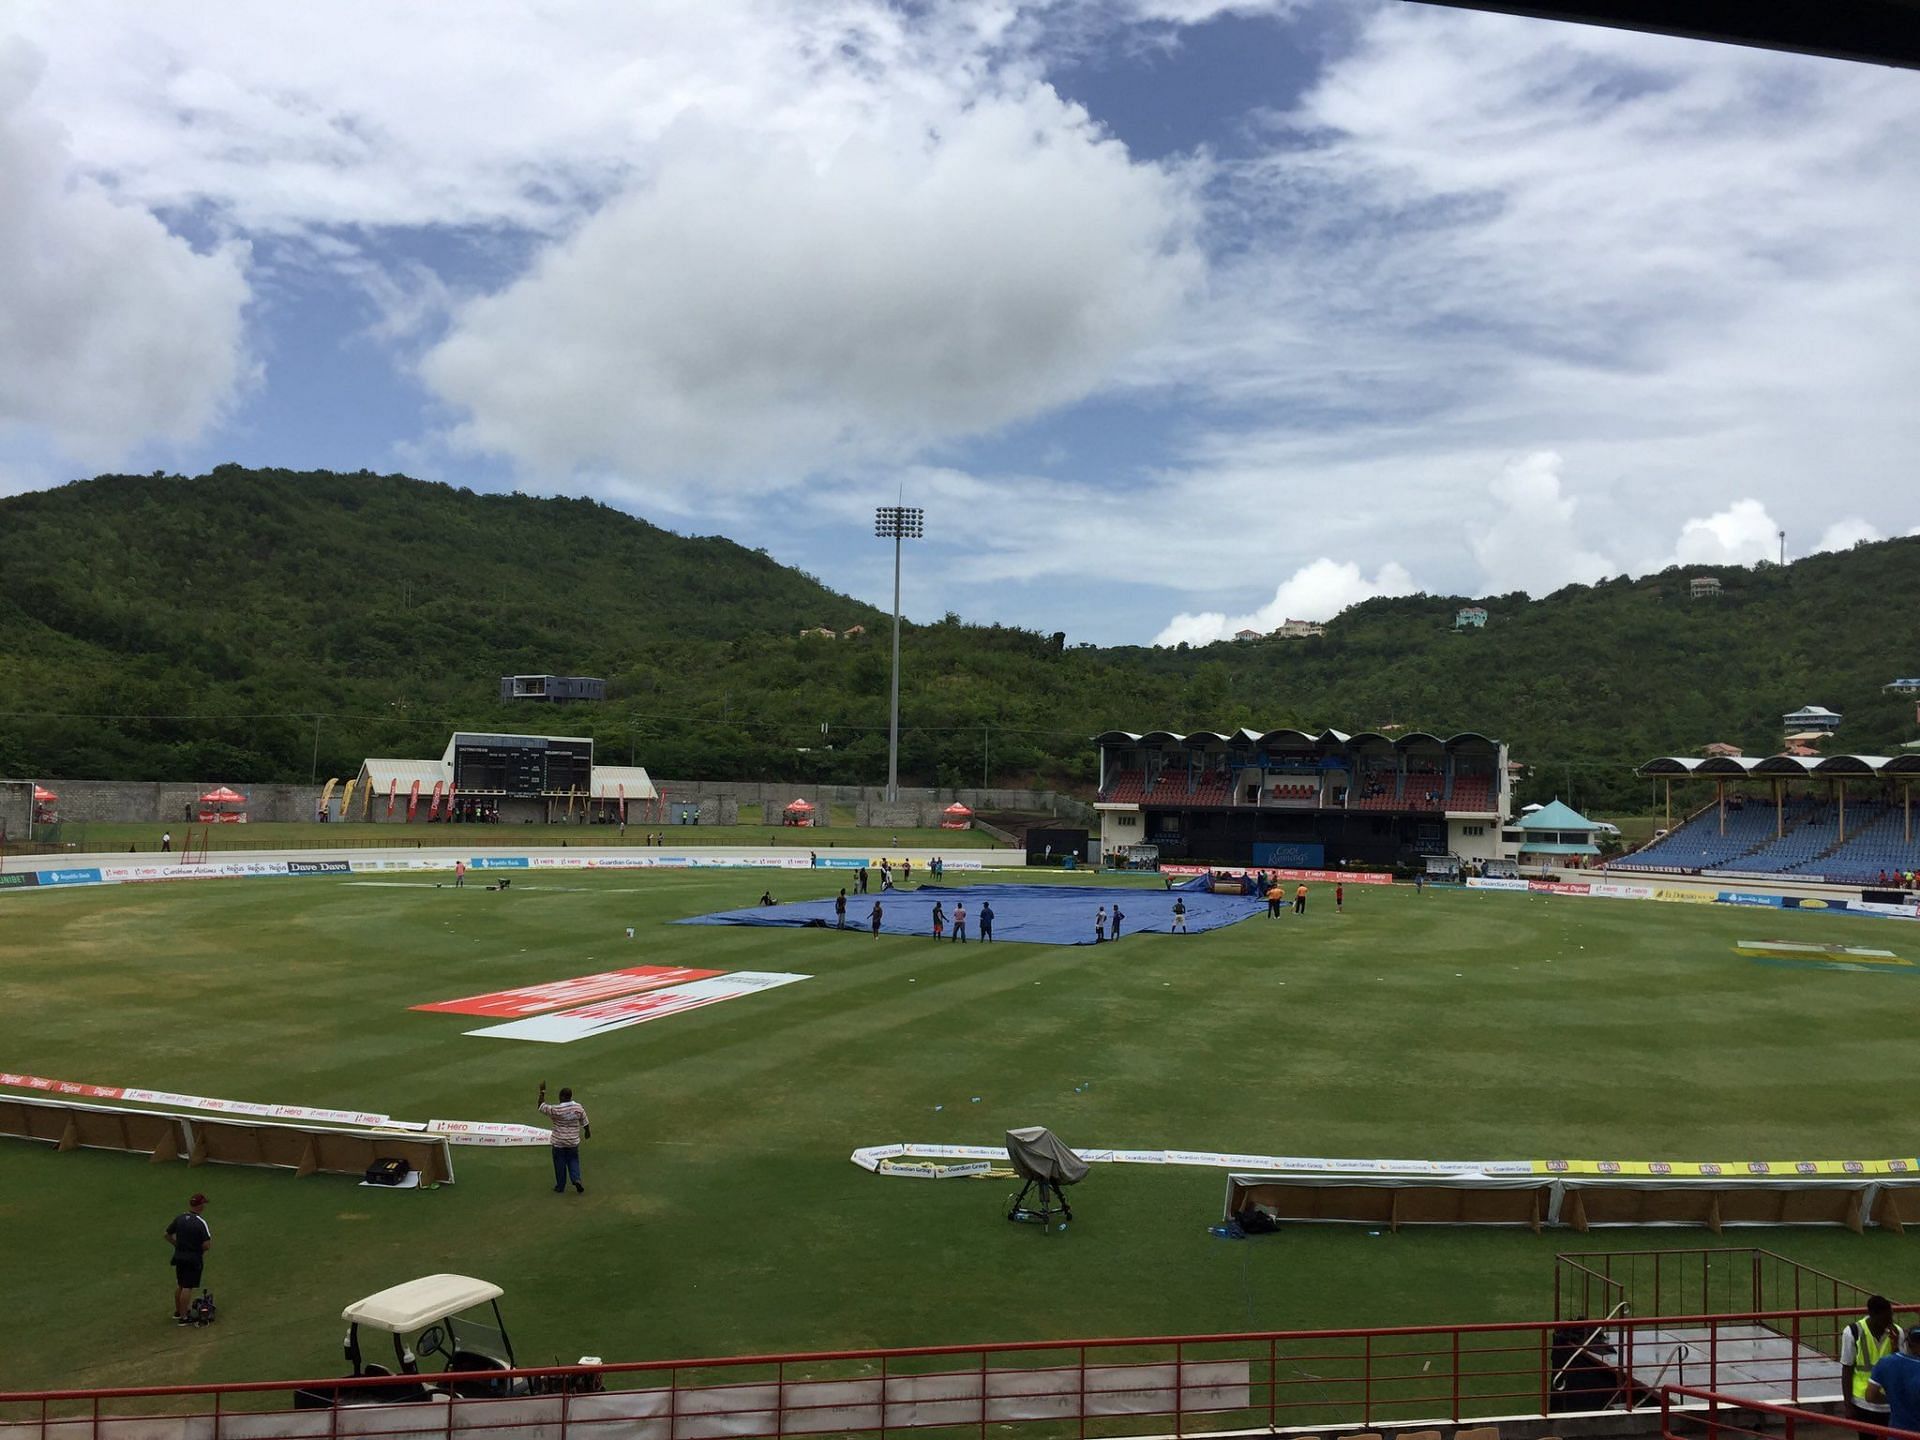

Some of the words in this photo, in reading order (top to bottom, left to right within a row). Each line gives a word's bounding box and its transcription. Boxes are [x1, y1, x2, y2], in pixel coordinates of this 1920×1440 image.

[1529, 882, 1549, 890] Digicel
[447, 1123, 468, 1131] Hero
[892, 1165, 915, 1173] Guardian
